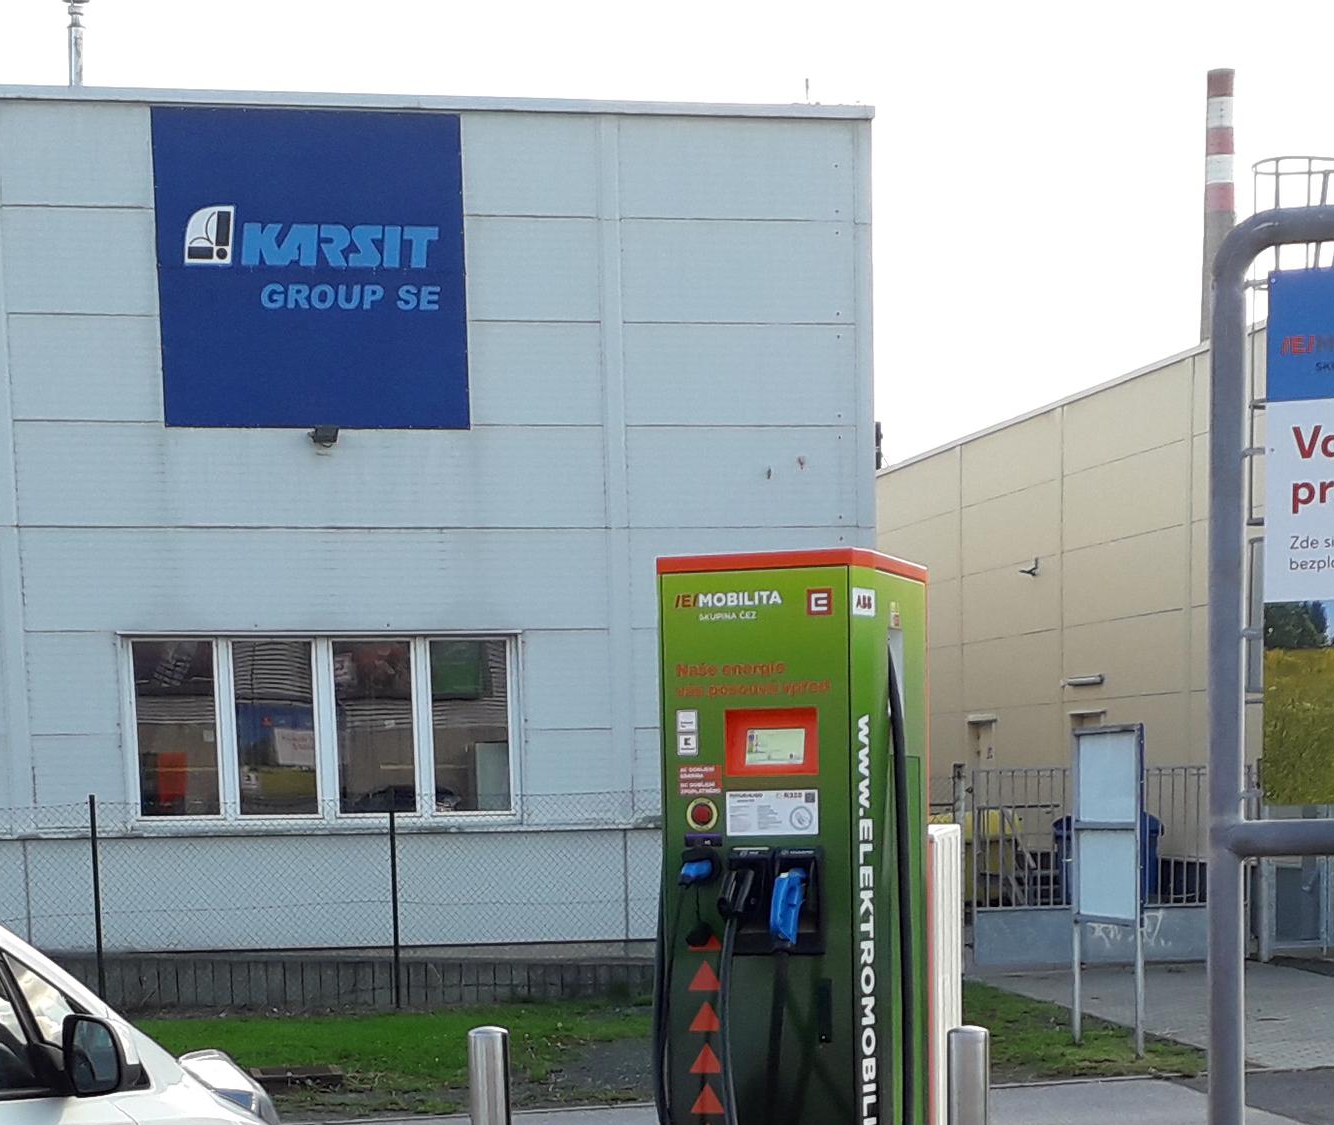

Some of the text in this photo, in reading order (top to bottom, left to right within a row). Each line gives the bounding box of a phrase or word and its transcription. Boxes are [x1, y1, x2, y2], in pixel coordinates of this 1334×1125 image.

[241, 222, 439, 269] KARSIT
[260, 282, 442, 312] GROUP SE
[1290, 535, 1318, 550] Zde
[1324, 537, 1334, 548] si
[856, 595, 872, 609] ABB
